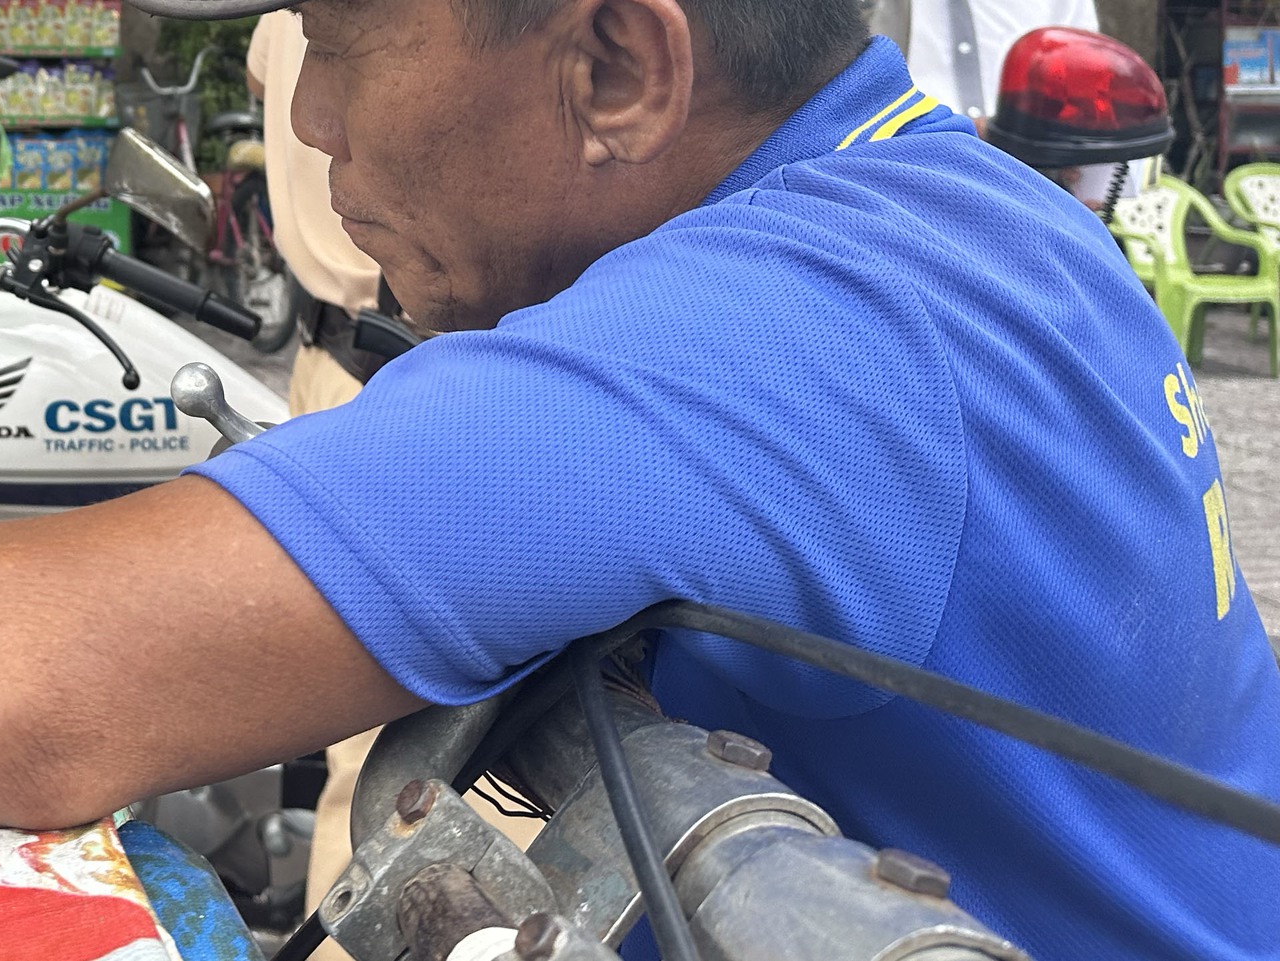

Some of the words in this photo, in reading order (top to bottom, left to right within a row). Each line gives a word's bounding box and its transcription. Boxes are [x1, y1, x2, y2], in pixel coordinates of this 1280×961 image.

[44, 397, 178, 433] CSGT
[43, 437, 114, 452] TRAFFIC
[129, 435, 189, 451] POLICE
